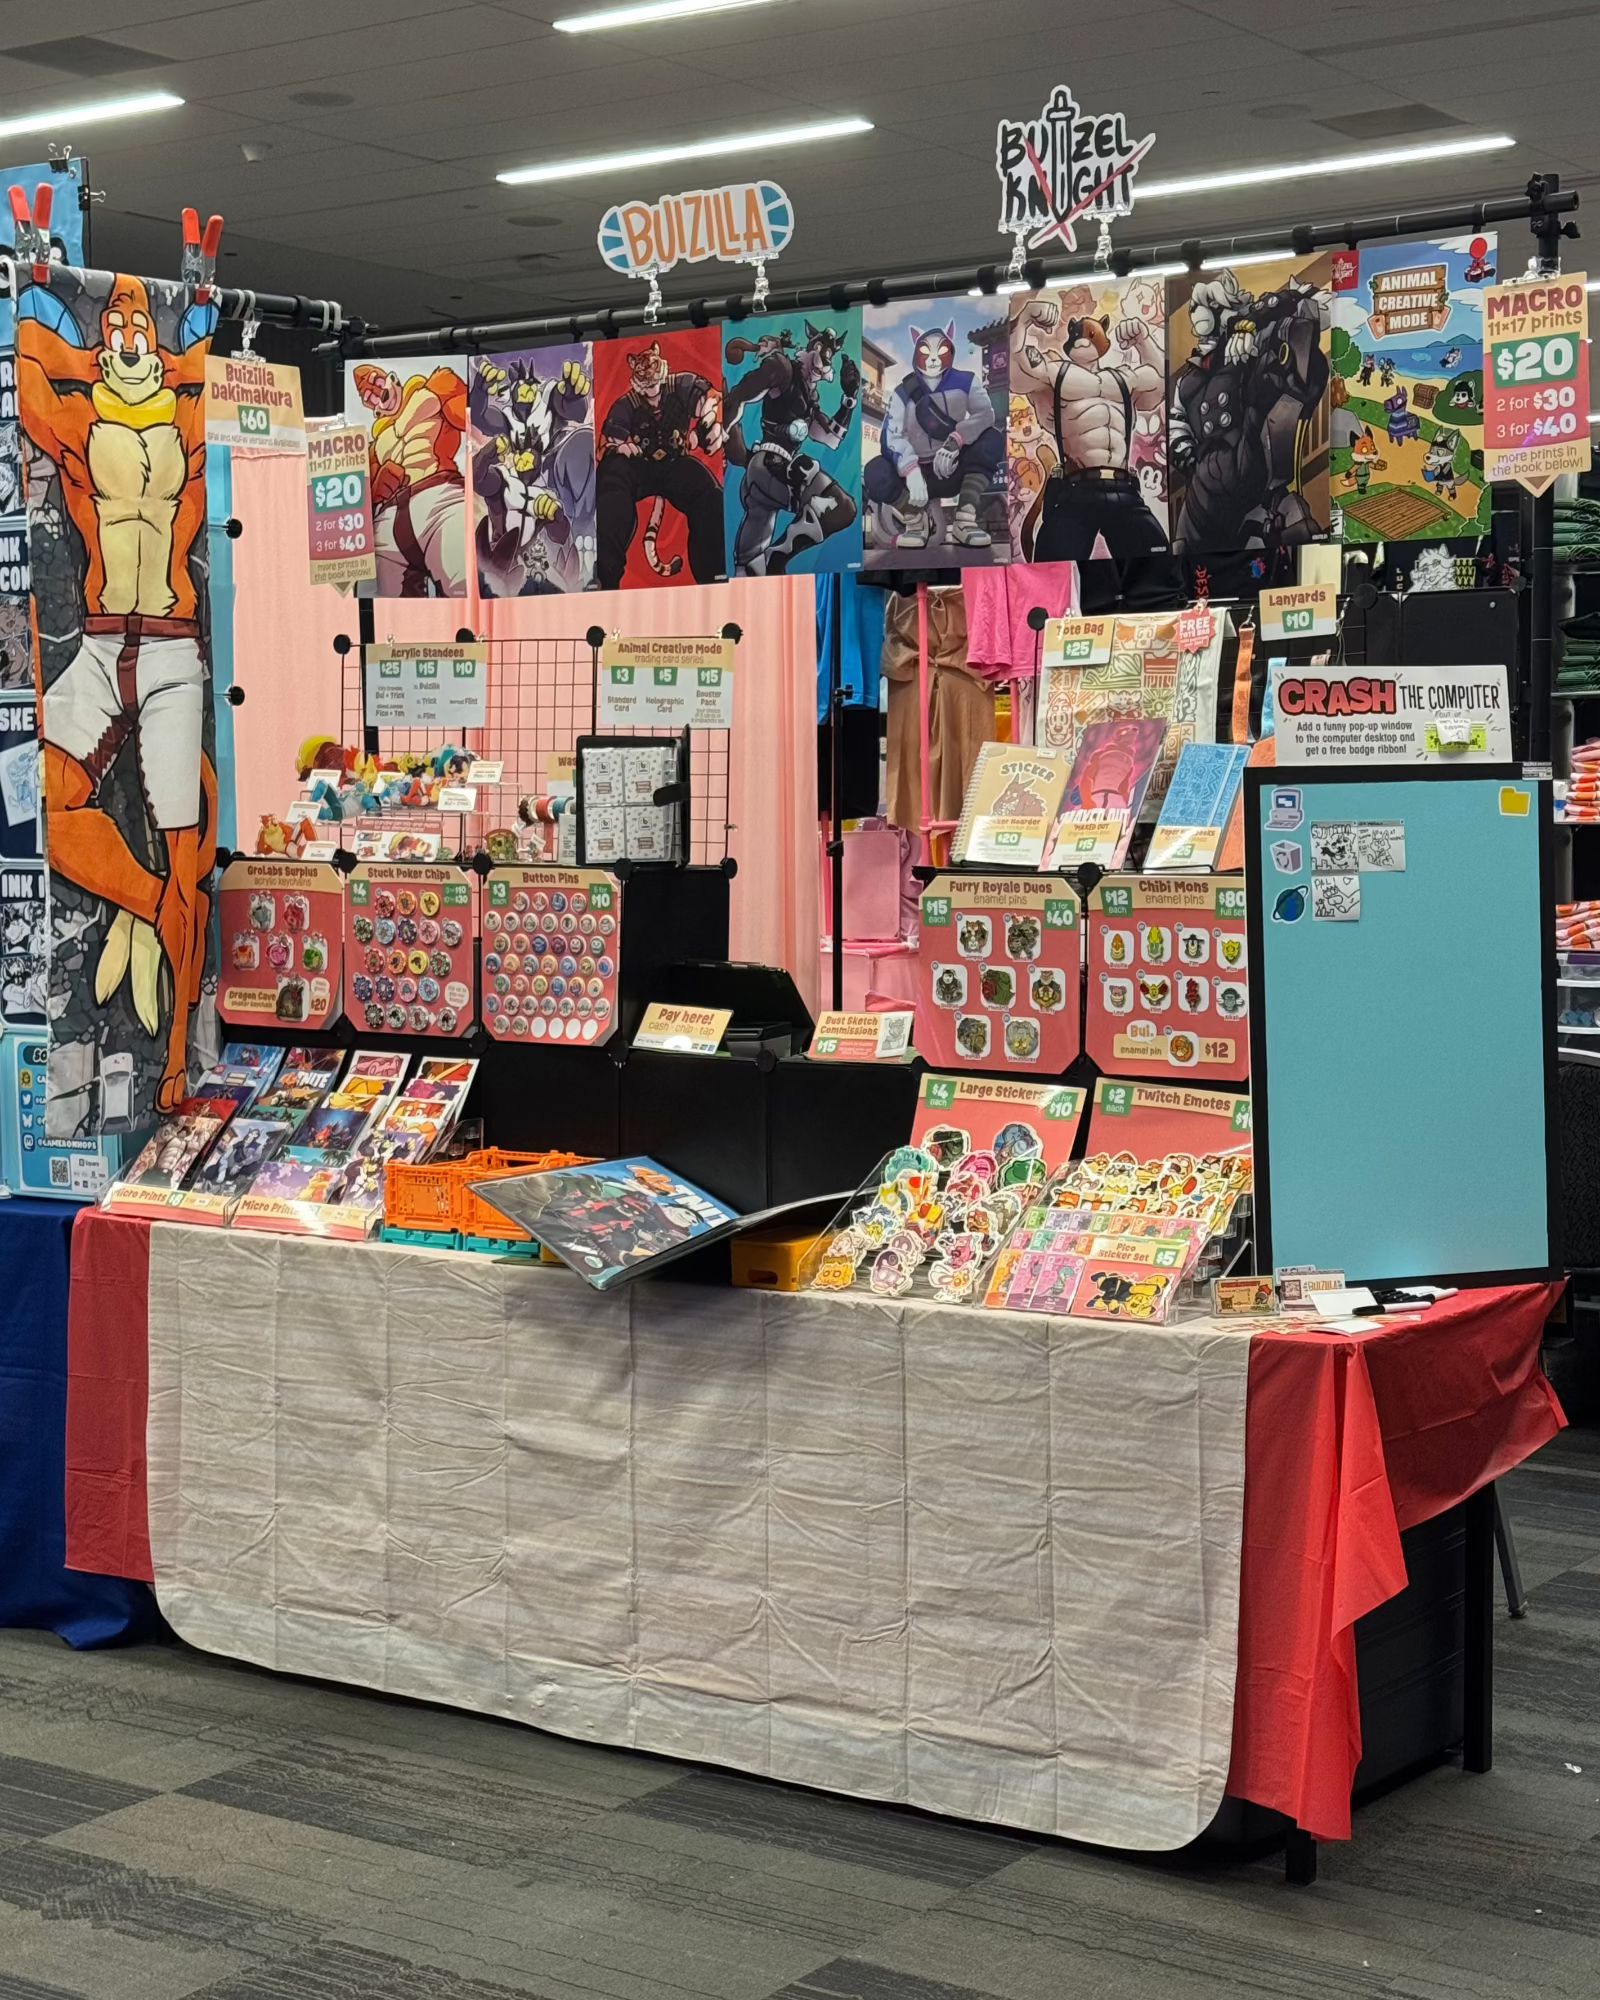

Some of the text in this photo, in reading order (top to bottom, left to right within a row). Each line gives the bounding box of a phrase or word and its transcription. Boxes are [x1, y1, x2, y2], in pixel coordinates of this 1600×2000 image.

[622, 187, 768, 266] BUIZILLA
[1381, 271, 1437, 291] ANIMAL
[1379, 293, 1438, 311] CREATIVE
[1487, 285, 1583, 320] MACRO
[1389, 312, 1427, 329] MODE
[1531, 311, 1582, 333] prints
[1497, 338, 1573, 381] $20
[225, 363, 275, 387] Buizilla
[211, 382, 292, 408] Dakimakura
[1496, 386, 1576, 412] 2 for $30
[241, 409, 267, 431] $60
[1496, 413, 1577, 438] 3 for $40
[308, 434, 365, 460] MACRO
[1497, 445, 1577, 464] more prints in
[335, 453, 366, 468] prints
[1492, 457, 1583, 477] the book below!
[315, 474, 362, 508] $20
[316, 512, 365, 532] 2 for $30
[316, 533, 366, 552] 3 for $40
[317, 558, 367, 572] more prints in
[327, 569, 345, 580] book
[1268, 590, 1326, 607] Lanyards
[1179, 616, 1209, 633] FREE
[1286, 611, 1309, 629] $10
[1084, 622, 1105, 636] Bag
[390, 647, 465, 660] Acrylic Standees
[618, 642, 722, 654] Animal Creative Mode
[1066, 641, 1090, 657] $25
[634, 654, 661, 665] trading
[662, 654, 680, 664] card
[381, 661, 473, 676] $25 $15 $10
[616, 667, 719, 684] $3 $5 $15
[607, 689, 722, 708] Standard Holographic Booster
[613, 697, 717, 713] Card Card Pack
[1278, 676, 1398, 718] CRASH
[1399, 684, 1501, 710] THE COMPUTER
[1296, 720, 1413, 734] Add a funny pop-up window
[1295, 731, 1415, 745] to the computer desktop and
[1305, 743, 1407, 757] get a free badge ribbon!
[1000, 762, 1055, 783] STICKER
[998, 834, 1019, 844] $20
[1078, 839, 1094, 850] $15
[247, 865, 318, 878] GroLabs Surplus
[367, 867, 451, 881] Stuck Poker Chips
[522, 872, 580, 884] Button Pins
[254, 877, 312, 888] acrylic keychains
[353, 882, 367, 897] $4
[493, 882, 506, 898] $3
[949, 880, 1053, 895] Furry Royale Duos
[1138, 879, 1209, 893] Chibi Mons
[591, 893, 610, 908] $10
[973, 894, 1028, 906] enamel pins
[1105, 889, 1246, 908] $12 $80
[1145, 894, 1205, 906] enamel pins
[926, 900, 948, 916] $15
[1057, 902, 1068, 910] for
[1108, 905, 1232, 917] each full
[928, 909, 1074, 927] each $40
[229, 991, 277, 1001] Dragon Cave
[310, 998, 327, 1011] $20
[658, 1008, 716, 1026] Pay here!
[825, 1016, 878, 1026] Bust Sketch
[648, 1021, 715, 1037] cash chip tap
[820, 1026, 879, 1036] Commissions
[1130, 1024, 1155, 1038] Bui.
[1120, 1047, 1162, 1056] enamel pin
[1204, 1042, 1229, 1058] $12
[932, 1083, 949, 1099] $4
[960, 1082, 993, 1098] Large
[1061, 1093, 1072, 1101] for
[1108, 1088, 1126, 1104] $2
[1137, 1089, 1181, 1105] Twitch
[1183, 1094, 1231, 1111] Emotes
[930, 1099, 1073, 1117] each $10
[1106, 1104, 1125, 1113] each
[140, 1190, 168, 1202] Prints
[241, 1200, 269, 1212] Micro
[1116, 1243, 1136, 1252] Pico
[1133, 1252, 1150, 1262] Set
[1156, 1250, 1177, 1266] $5
